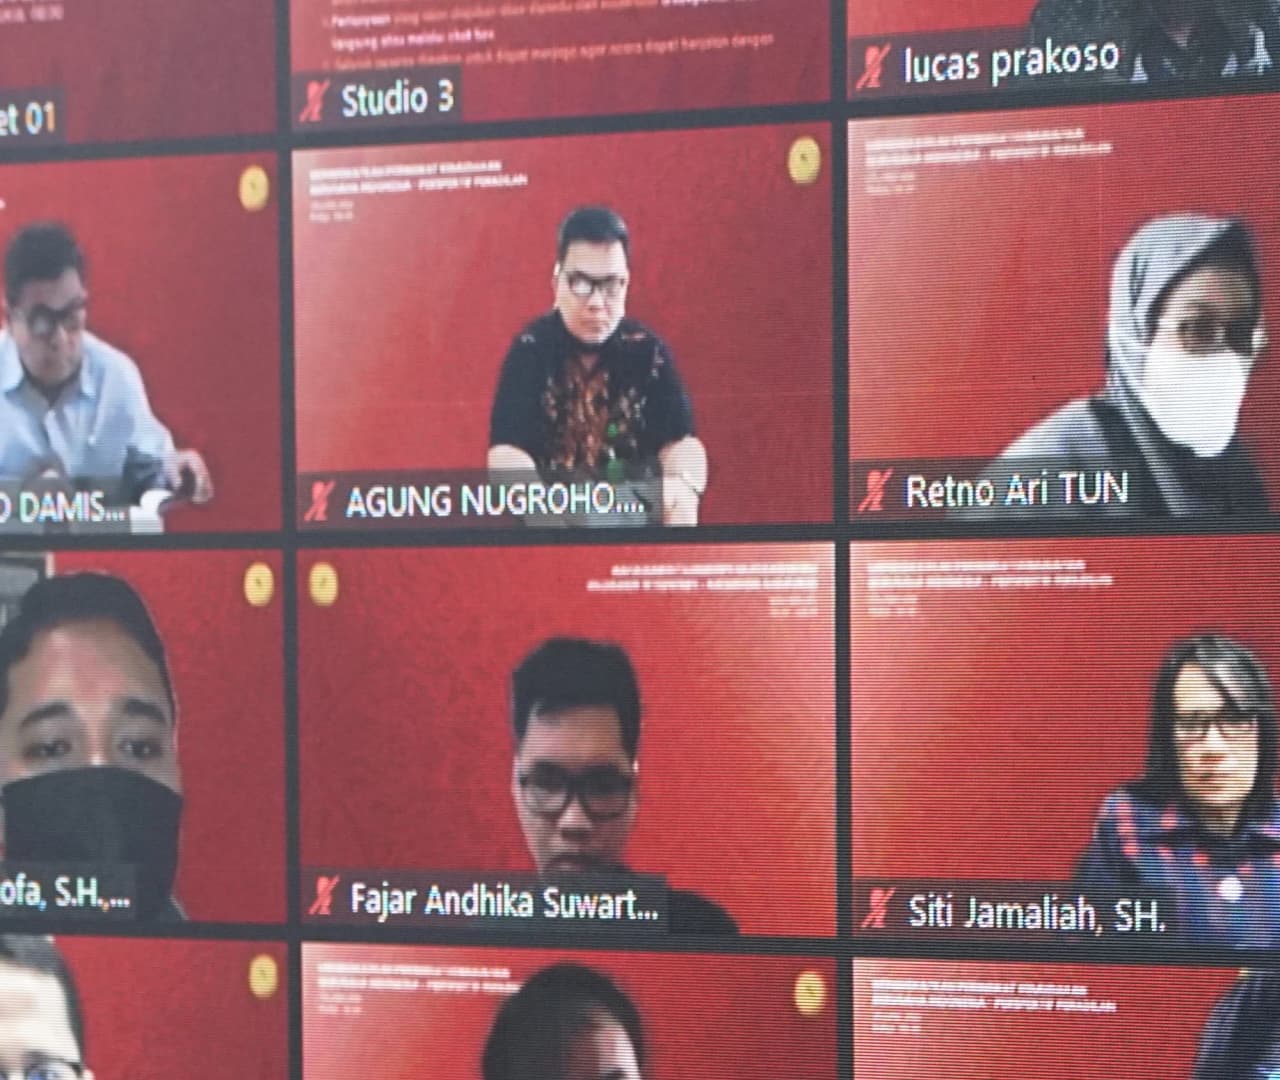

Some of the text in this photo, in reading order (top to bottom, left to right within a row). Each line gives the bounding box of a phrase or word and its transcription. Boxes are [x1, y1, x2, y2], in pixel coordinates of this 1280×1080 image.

[904, 37, 1120, 87] lucas prakoso
[342, 77, 455, 118] Studio 3
[25, 101, 58, 135] 01
[19, 491, 125, 524] DAMIS...
[346, 485, 452, 518] AGUNG
[906, 468, 1129, 508] Retno Ari TUN
[350, 880, 659, 923] Fajar Andhika Suwart...
[908, 891, 1167, 937] Siti Jamaliah, SH.
